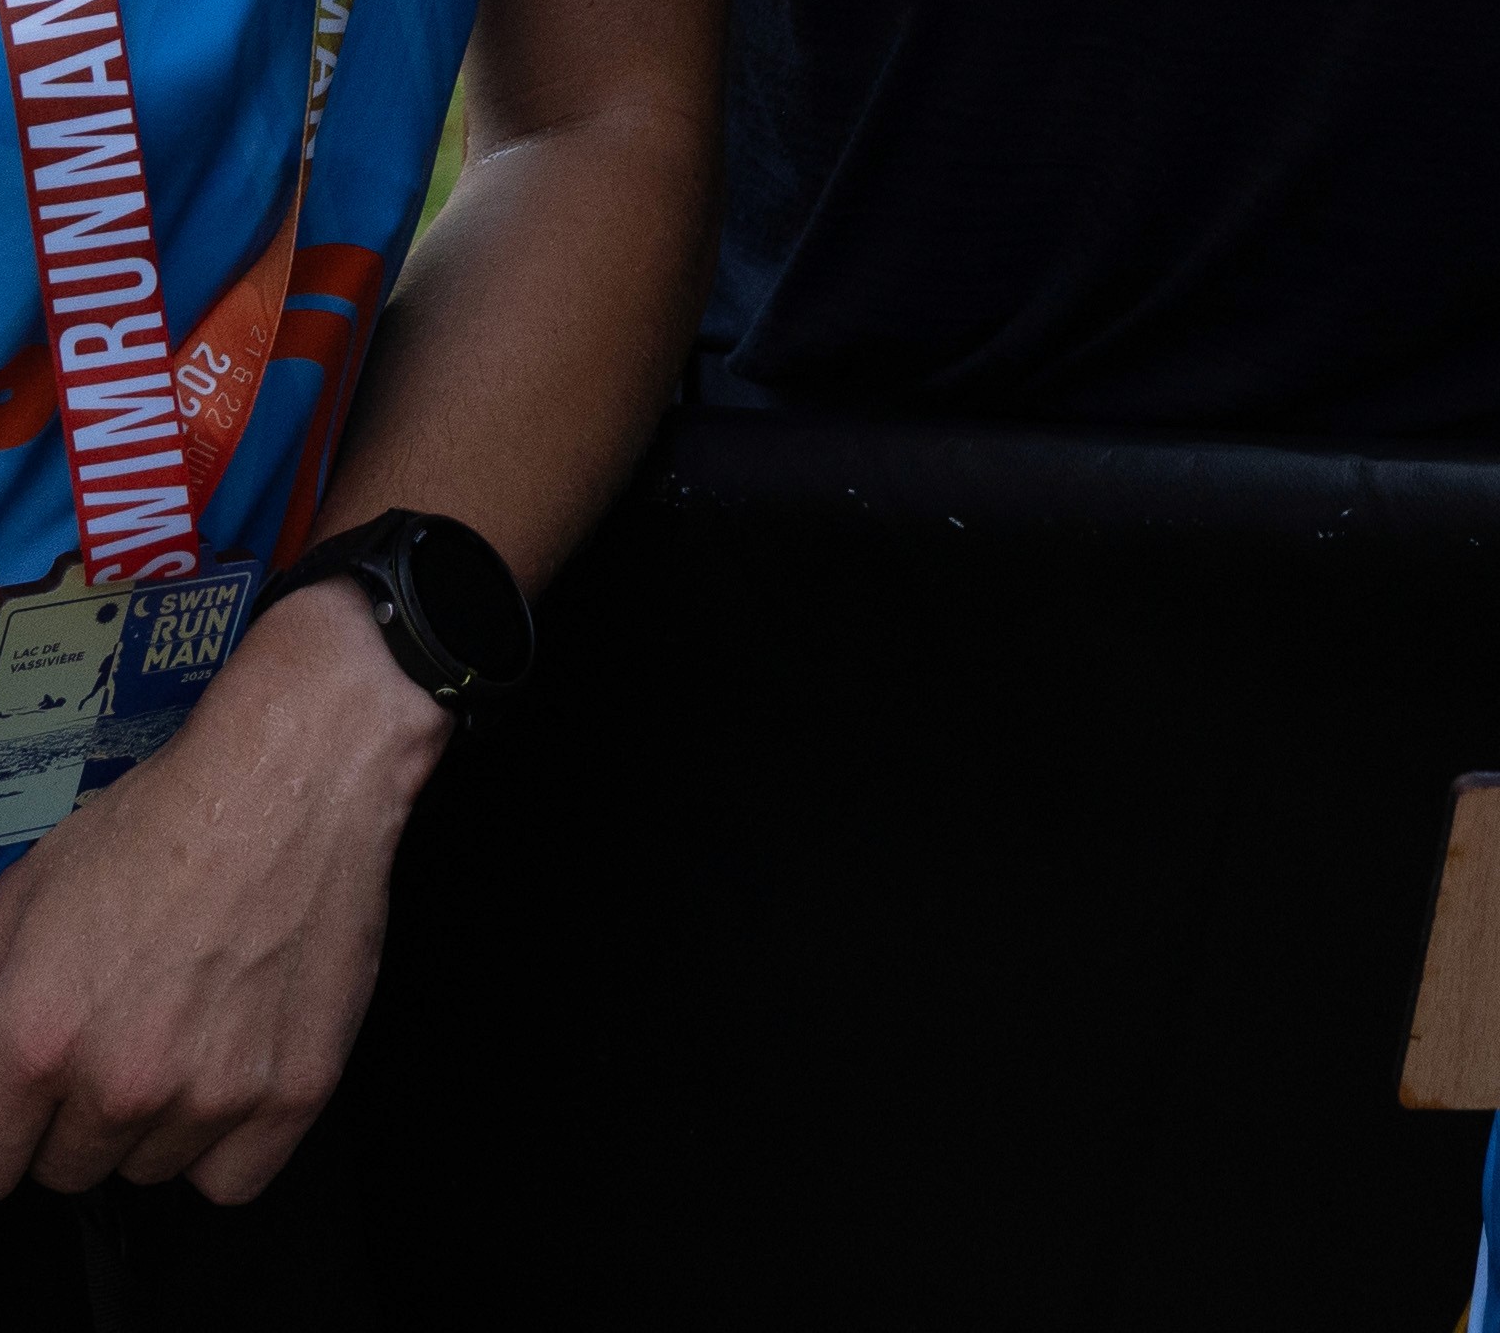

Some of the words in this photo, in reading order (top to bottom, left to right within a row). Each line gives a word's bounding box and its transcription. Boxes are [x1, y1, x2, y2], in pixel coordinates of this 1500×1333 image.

[246, 324, 268, 358] 21
[176, 341, 232, 435] 202
[204, 391, 242, 430] 22
[159, 582, 239, 615] SWIM
[151, 605, 233, 644] RUN
[12, 643, 39, 661] LAC
[42, 642, 62, 656] DE
[141, 634, 224, 674] MAN
[180, 668, 214, 684] 2025
